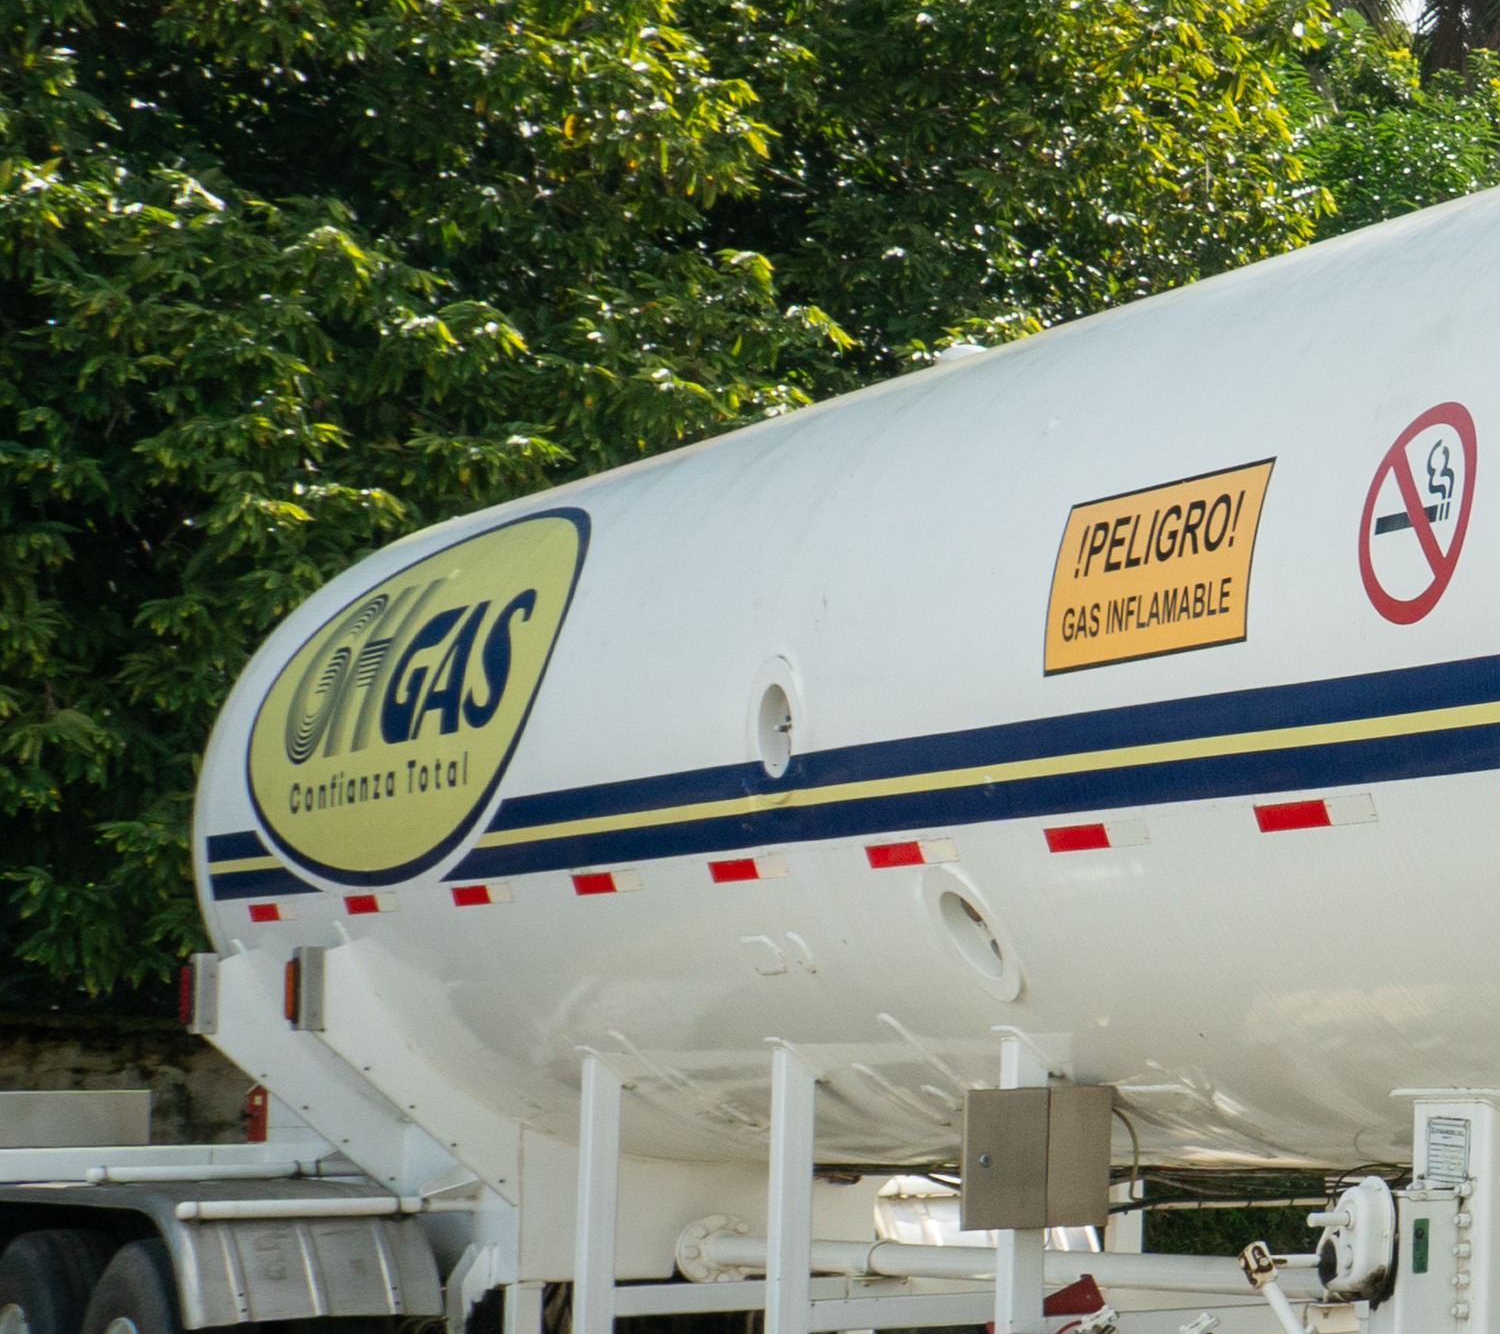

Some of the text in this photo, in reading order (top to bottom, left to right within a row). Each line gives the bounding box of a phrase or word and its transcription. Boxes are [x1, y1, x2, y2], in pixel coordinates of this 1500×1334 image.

[1061, 576, 1232, 642] GAS INFLAMABLE
[289, 750, 468, 814] Confianza Total
